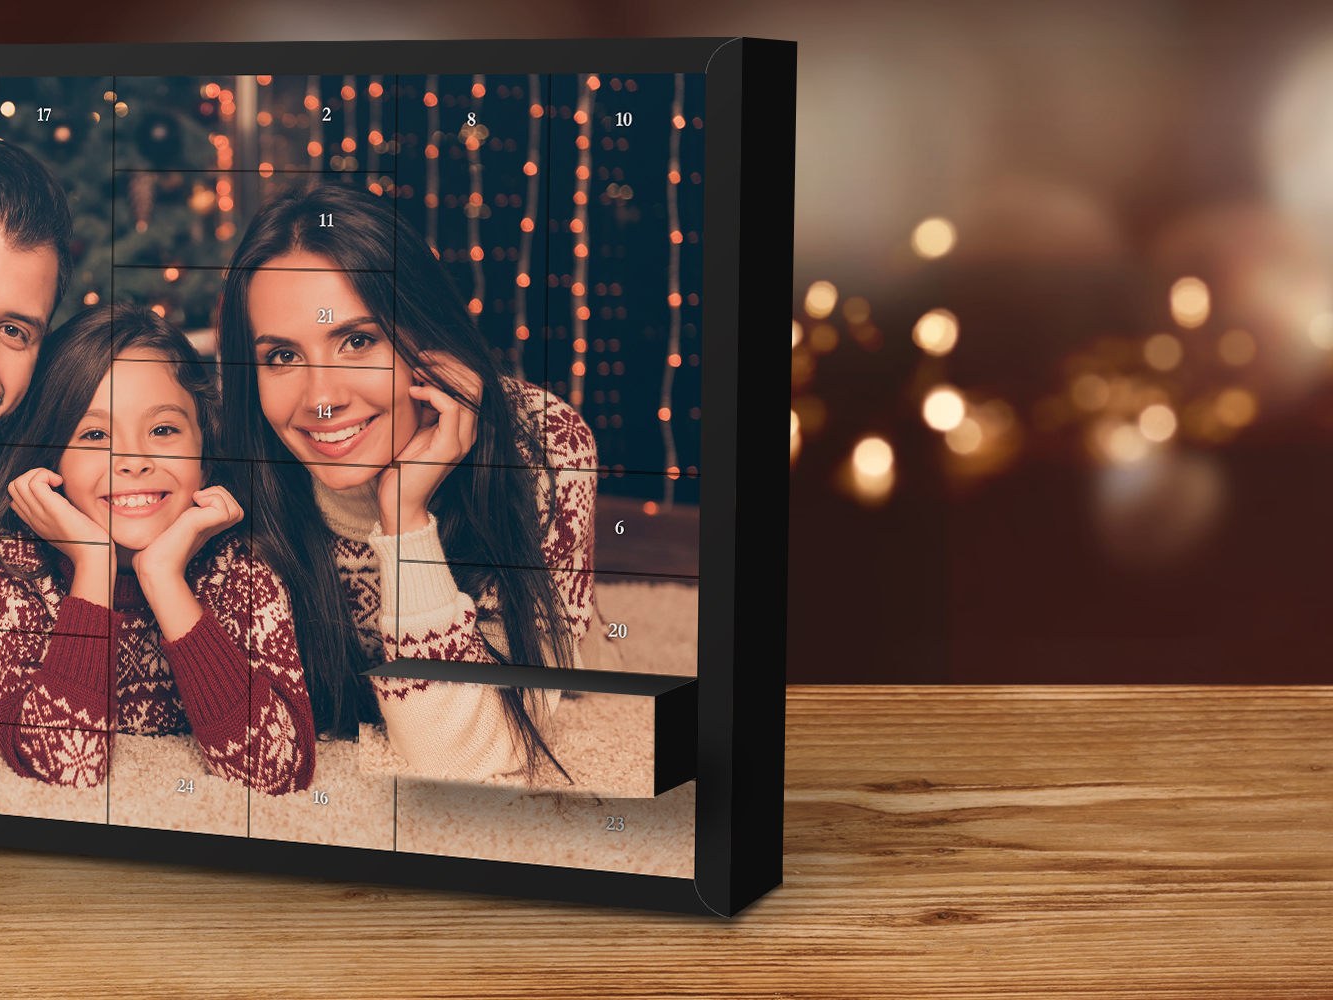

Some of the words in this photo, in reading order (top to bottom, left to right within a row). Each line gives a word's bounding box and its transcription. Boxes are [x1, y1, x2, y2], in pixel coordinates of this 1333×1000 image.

[36, 108, 52, 122] 17
[322, 107, 332, 122] 2
[467, 112, 476, 127] 8
[615, 112, 632, 127] 10
[319, 213, 334, 227] 11
[317, 308, 334, 324] 21
[316, 404, 332, 419] 14
[615, 520, 625, 535] 6
[608, 623, 628, 639] 20
[177, 778, 194, 794] 24
[313, 790, 329, 805] 16
[606, 816, 625, 831] 23
